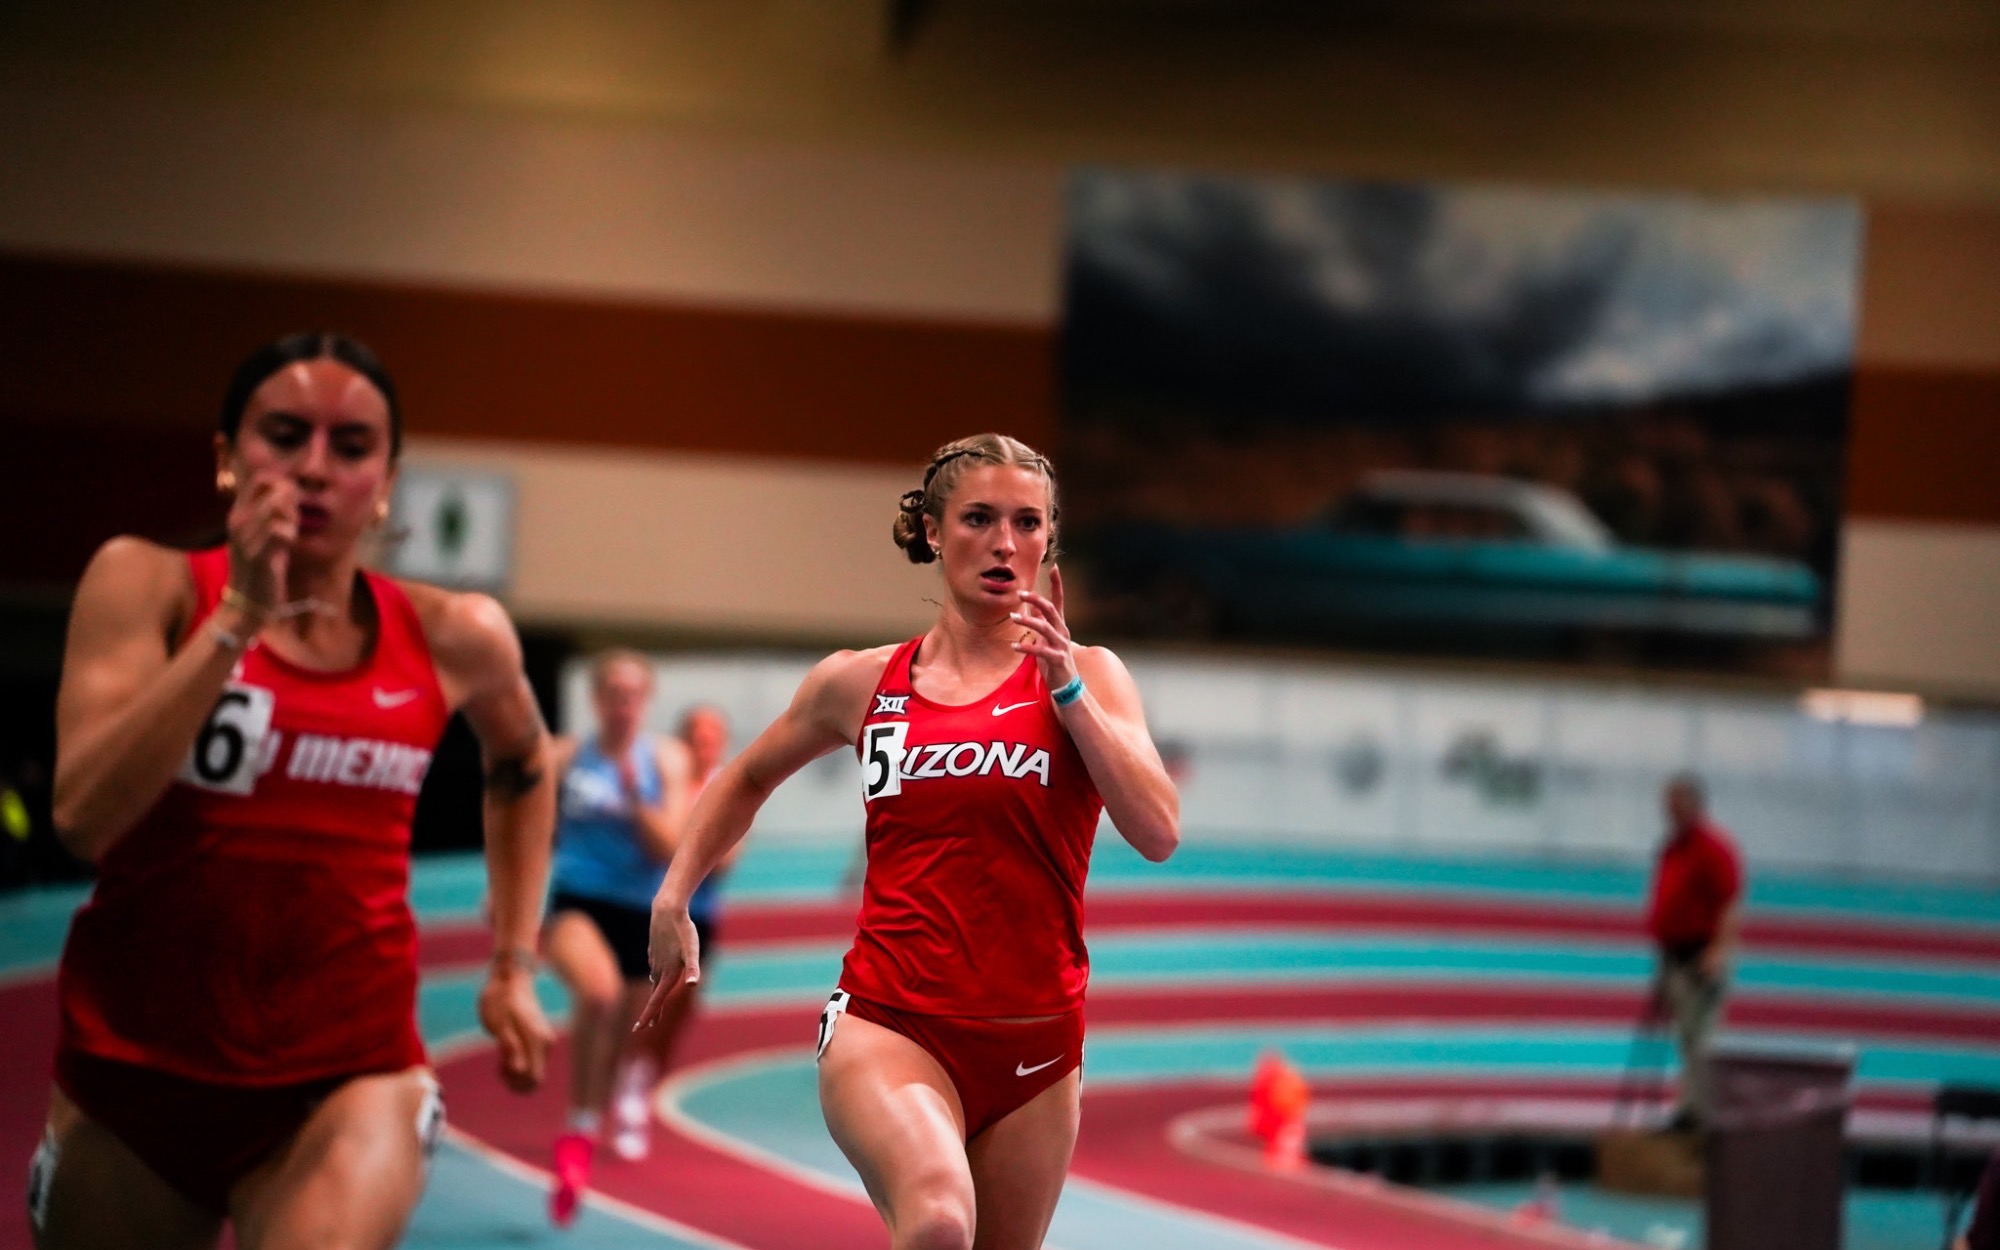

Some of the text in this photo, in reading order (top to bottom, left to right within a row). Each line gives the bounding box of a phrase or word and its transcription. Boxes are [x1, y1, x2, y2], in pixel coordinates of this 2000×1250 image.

[194, 692, 250, 784] 6
[872, 694, 911, 715] XII
[868, 727, 896, 796] 5
